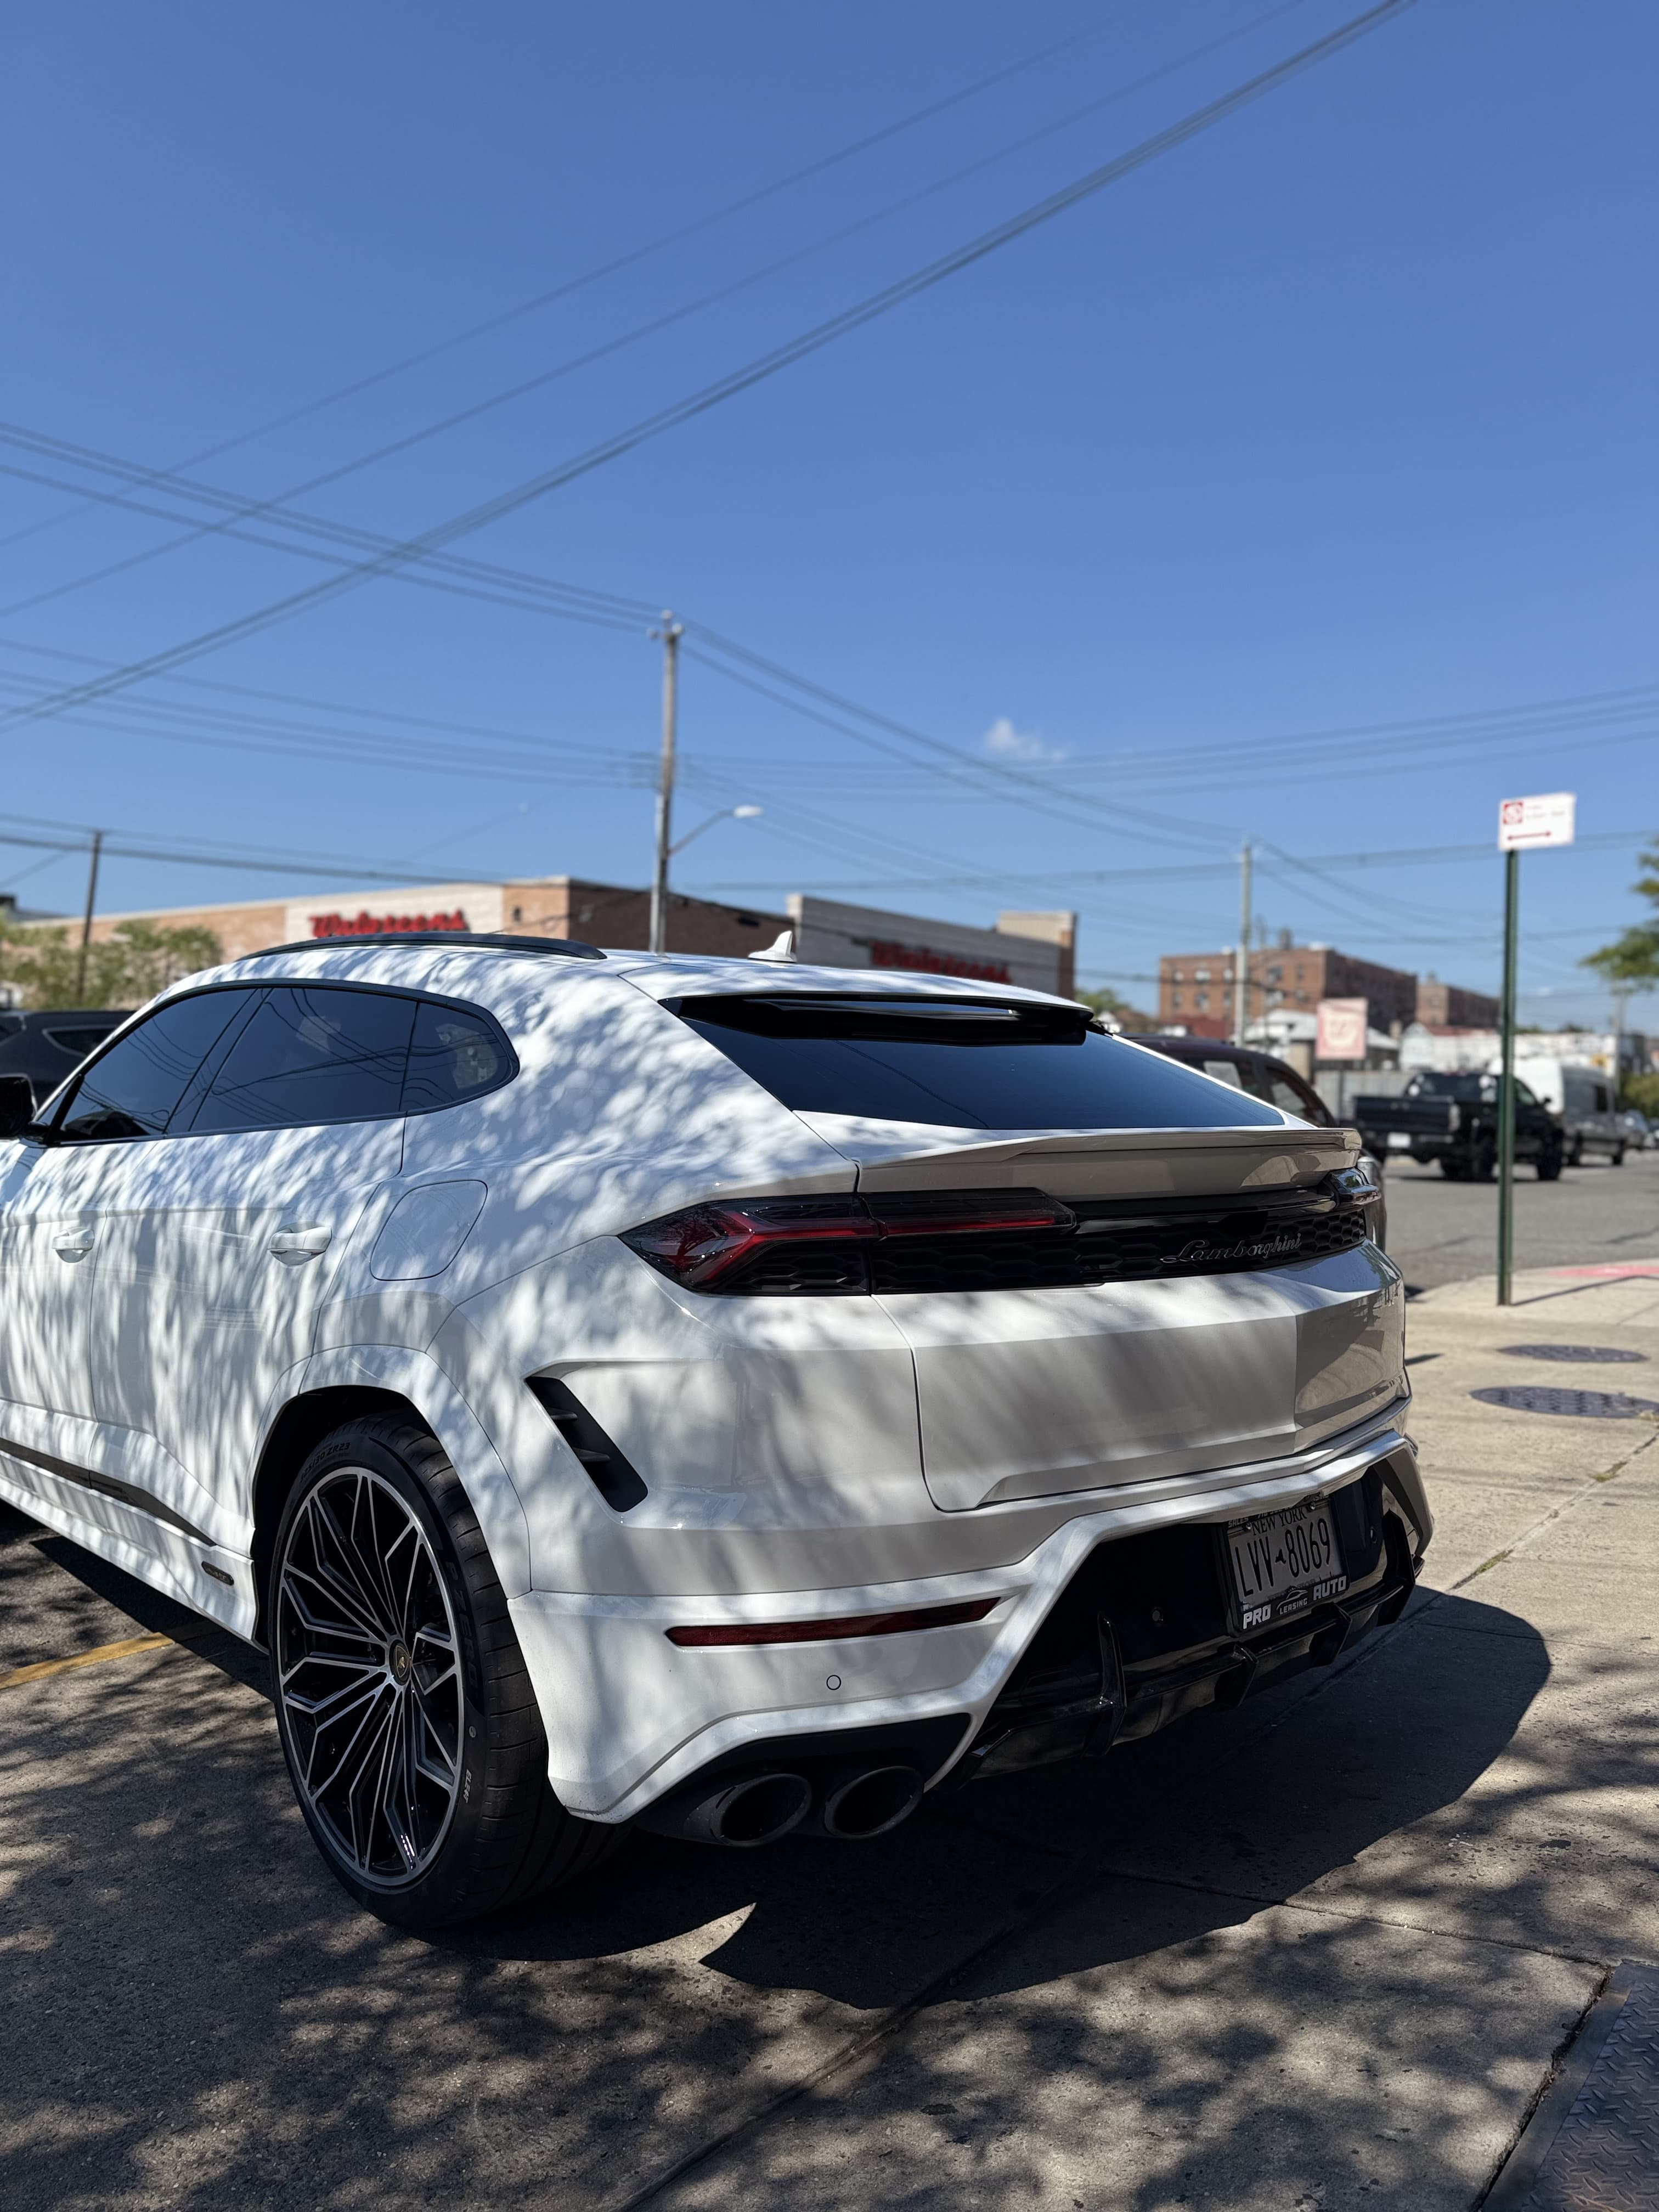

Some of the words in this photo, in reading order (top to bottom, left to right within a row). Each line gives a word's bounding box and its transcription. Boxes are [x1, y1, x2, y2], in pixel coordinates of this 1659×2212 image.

[1160, 1234, 1302, 1263] Lamborghini
[1251, 1517, 1276, 1536] NEW
[1279, 1507, 1307, 1527] YORK
[1235, 1536, 1274, 1597] LVV
[1285, 1518, 1330, 1578] 8069
[1243, 1604, 1271, 1630] PRO
[1312, 1575, 1347, 1601] AUTO
[1279, 1597, 1308, 1615] LEASING
